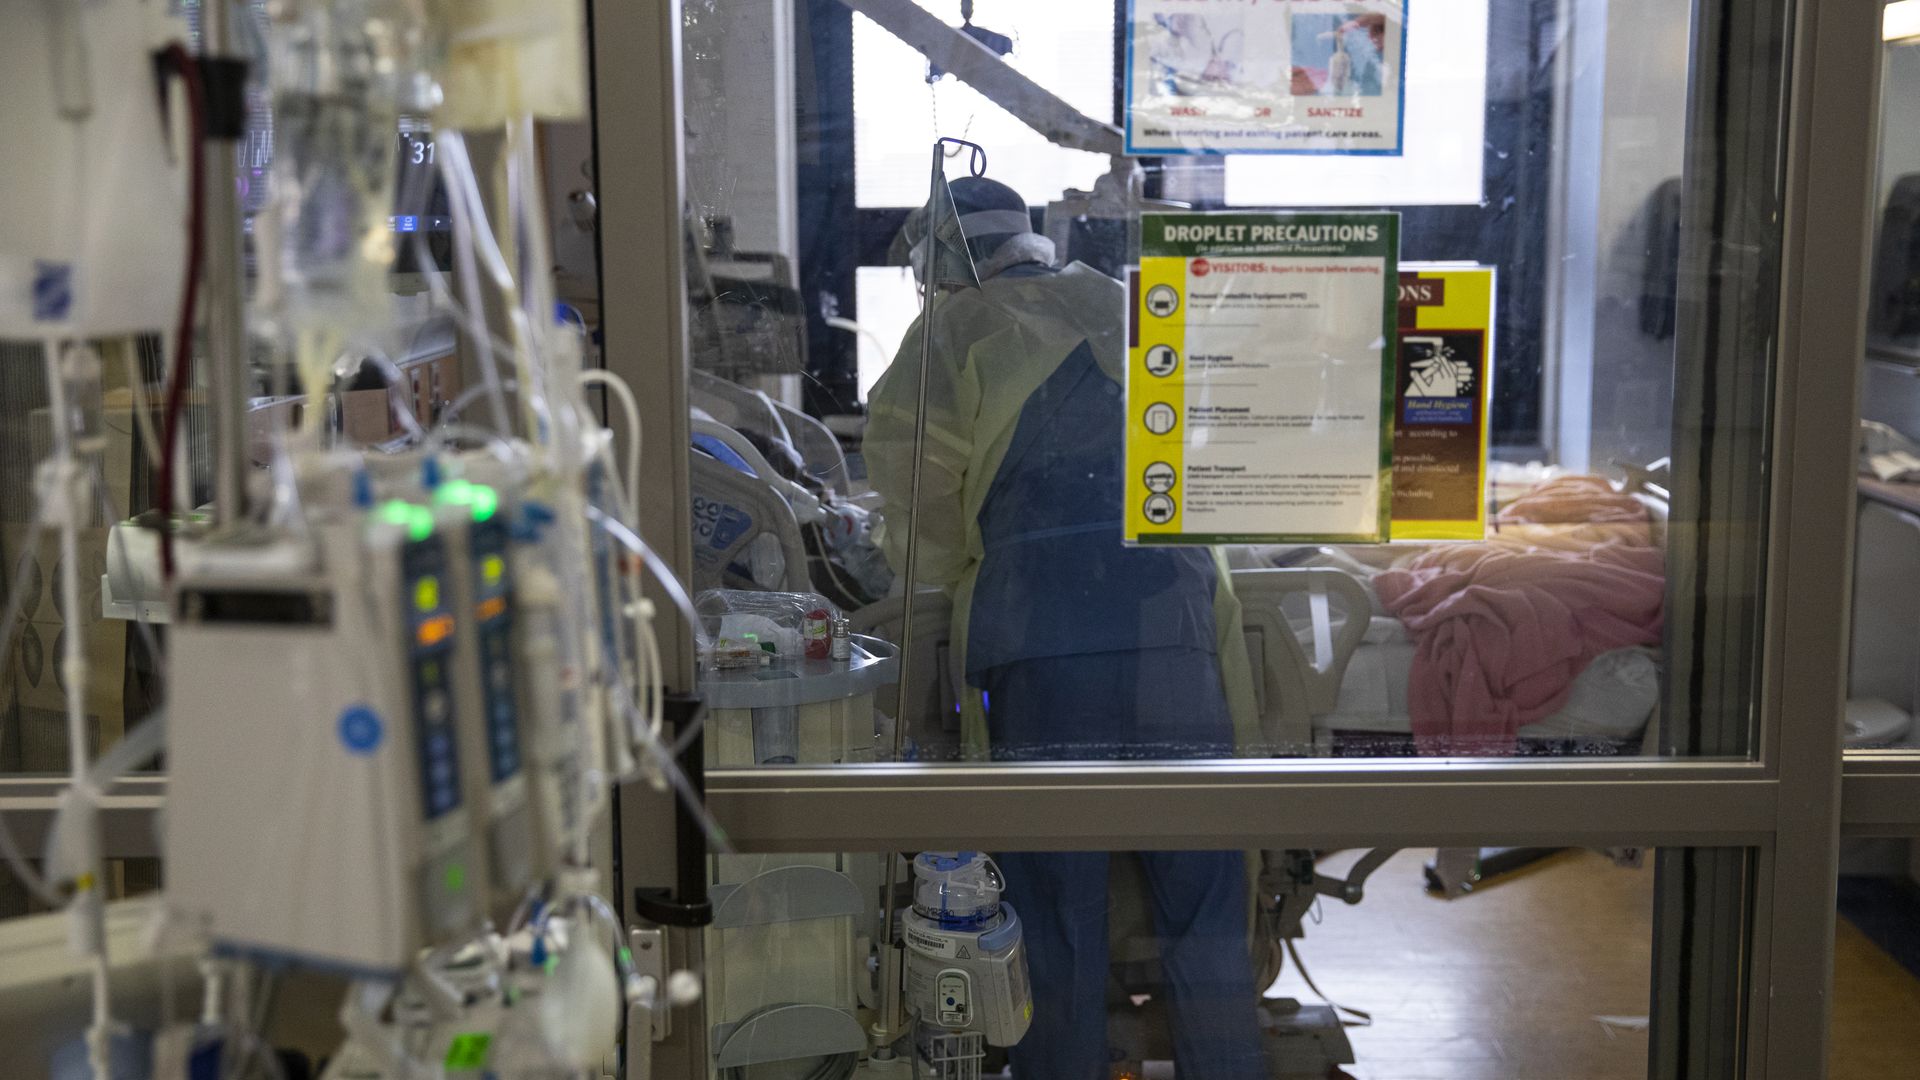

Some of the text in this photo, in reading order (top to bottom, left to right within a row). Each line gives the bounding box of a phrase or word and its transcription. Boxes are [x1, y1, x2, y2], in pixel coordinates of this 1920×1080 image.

[1143, 128, 1171, 137] When
[1223, 129, 1243, 137] and
[1325, 130, 1348, 138] care
[1351, 130, 1383, 138] areas.
[412, 141, 436, 164] 31
[1164, 225, 1379, 242] DROPLET PRECAUTIONS
[1211, 263, 1269, 273] VISITORS:
